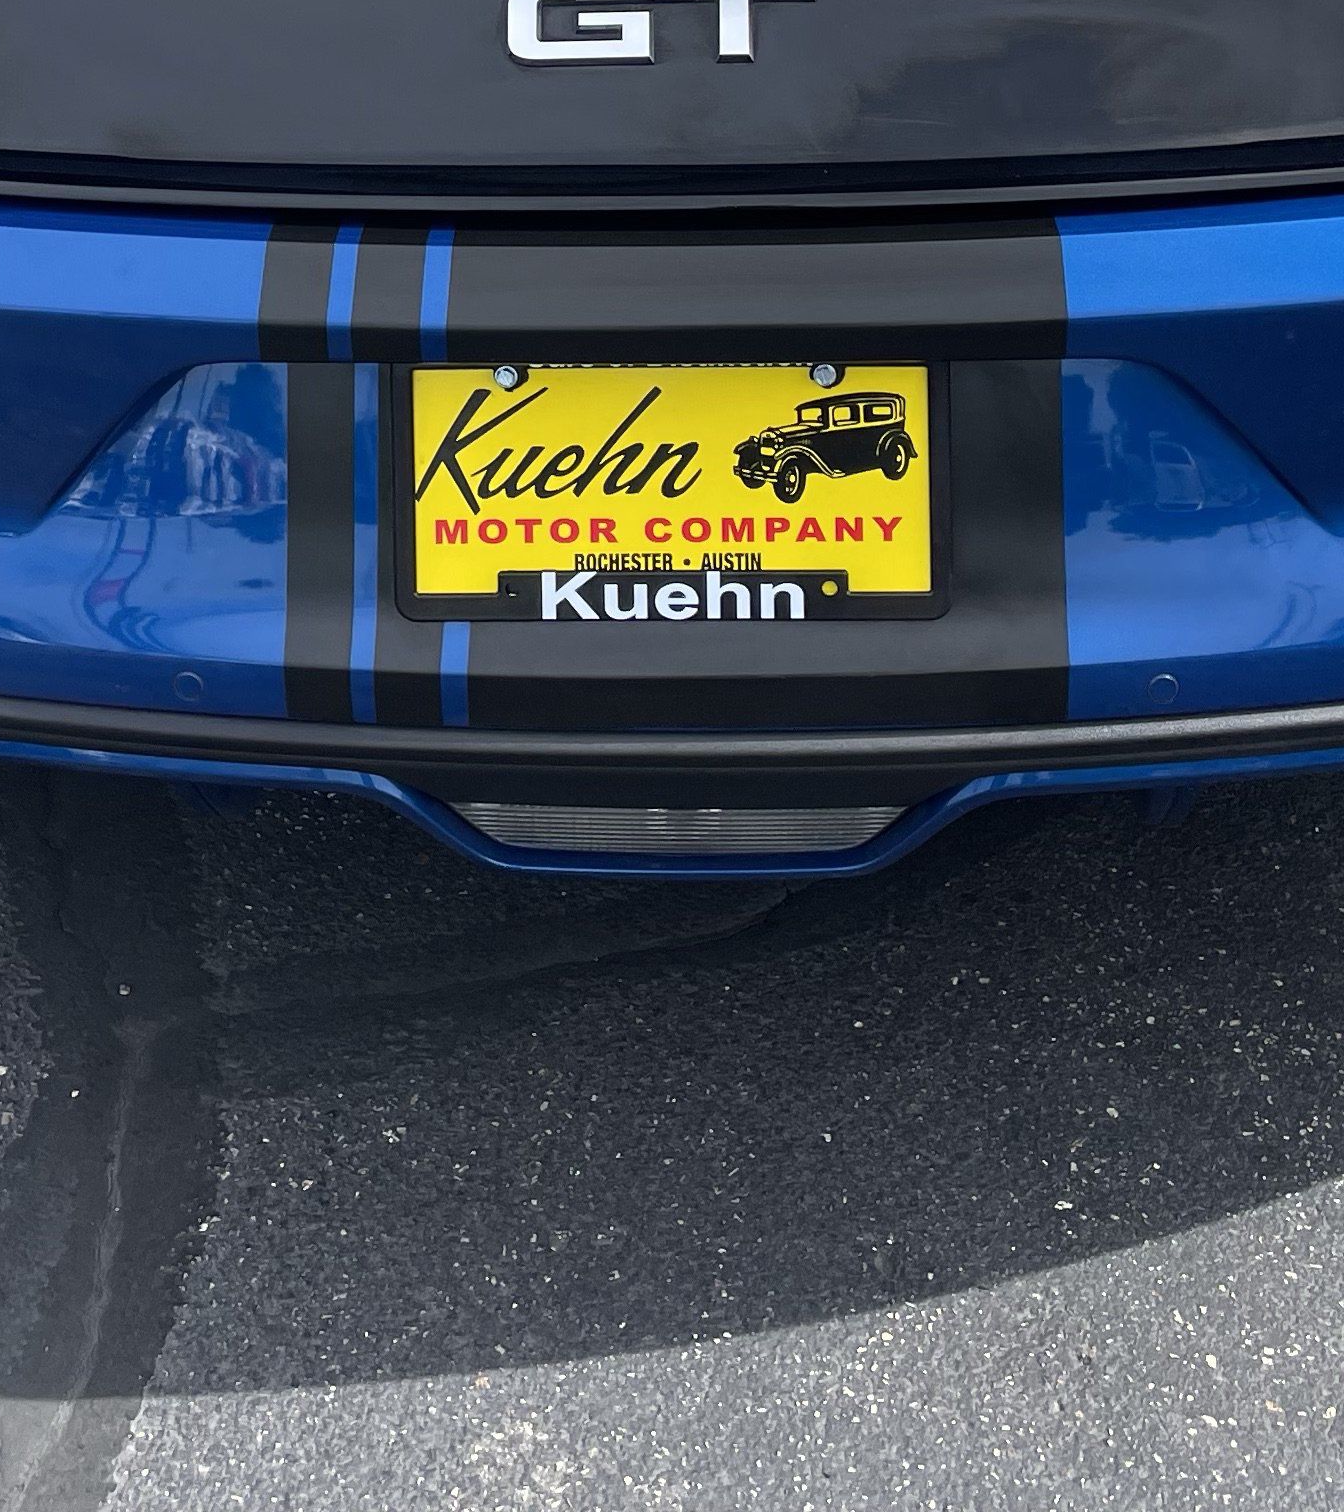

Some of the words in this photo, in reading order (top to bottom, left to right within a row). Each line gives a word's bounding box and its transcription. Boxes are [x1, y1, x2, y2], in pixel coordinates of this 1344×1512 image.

[413, 386, 703, 515] Kuehn
[435, 517, 620, 545] MOTOR
[644, 515, 904, 544] COMPANY
[574, 552, 673, 571] ROCHESTER
[700, 551, 763, 571] AUSTIN
[541, 570, 806, 621] Kuehn
